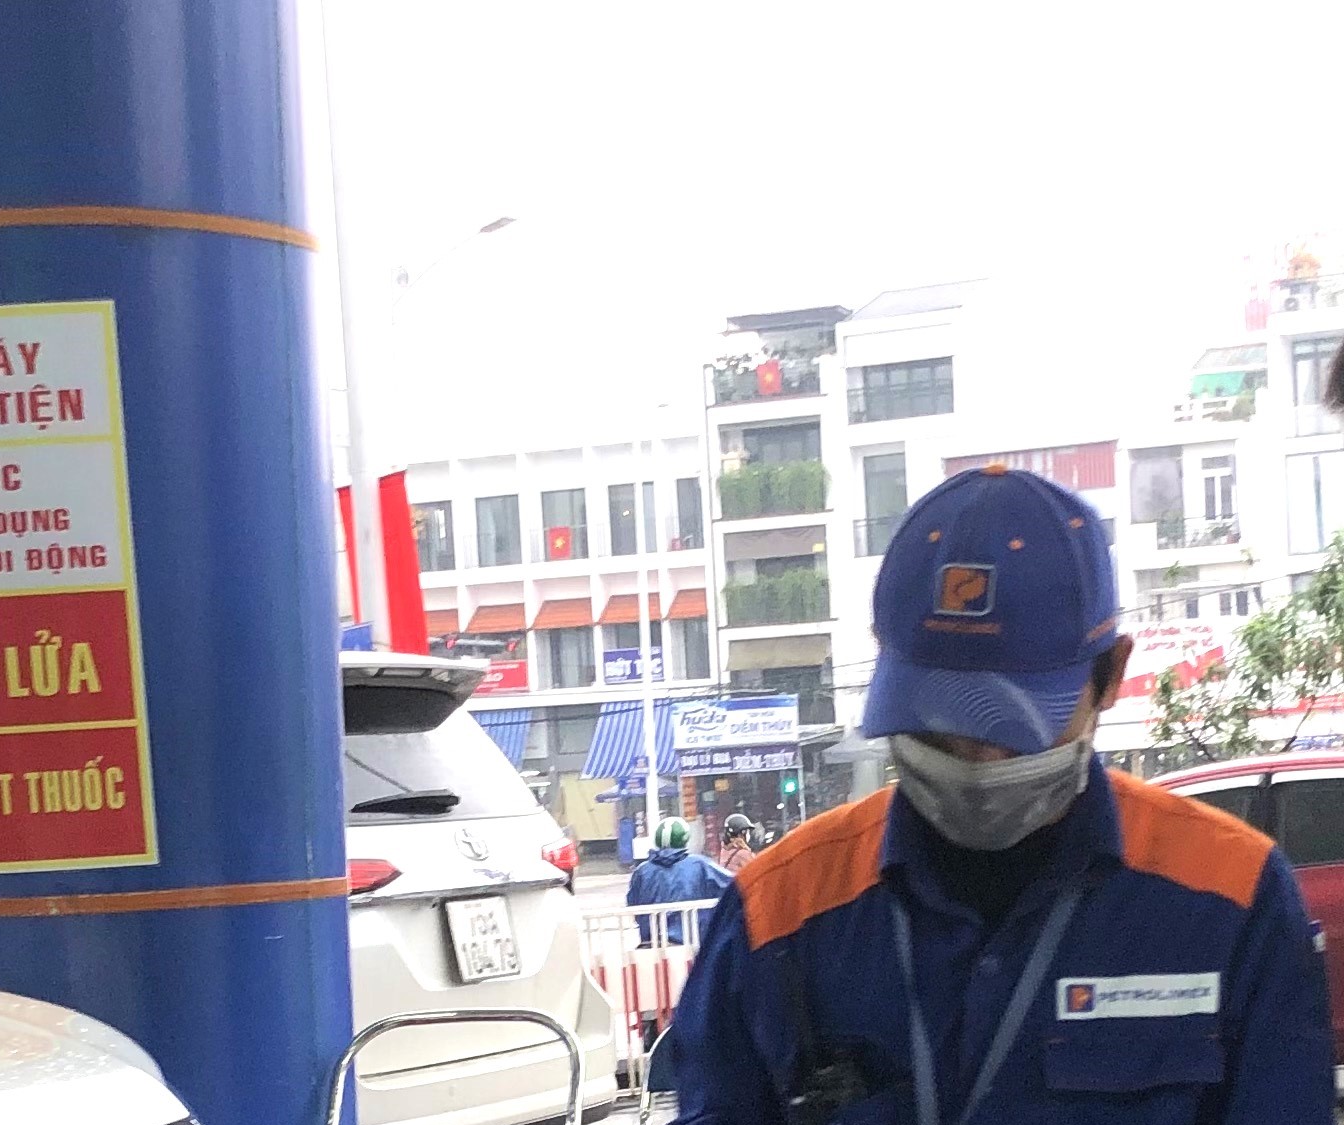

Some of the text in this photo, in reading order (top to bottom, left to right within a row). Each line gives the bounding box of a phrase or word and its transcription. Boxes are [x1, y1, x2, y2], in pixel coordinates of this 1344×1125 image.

[25, 543, 108, 575] ĐỘNG
[4, 629, 102, 698] LỬA
[23, 755, 126, 814] THUỐC
